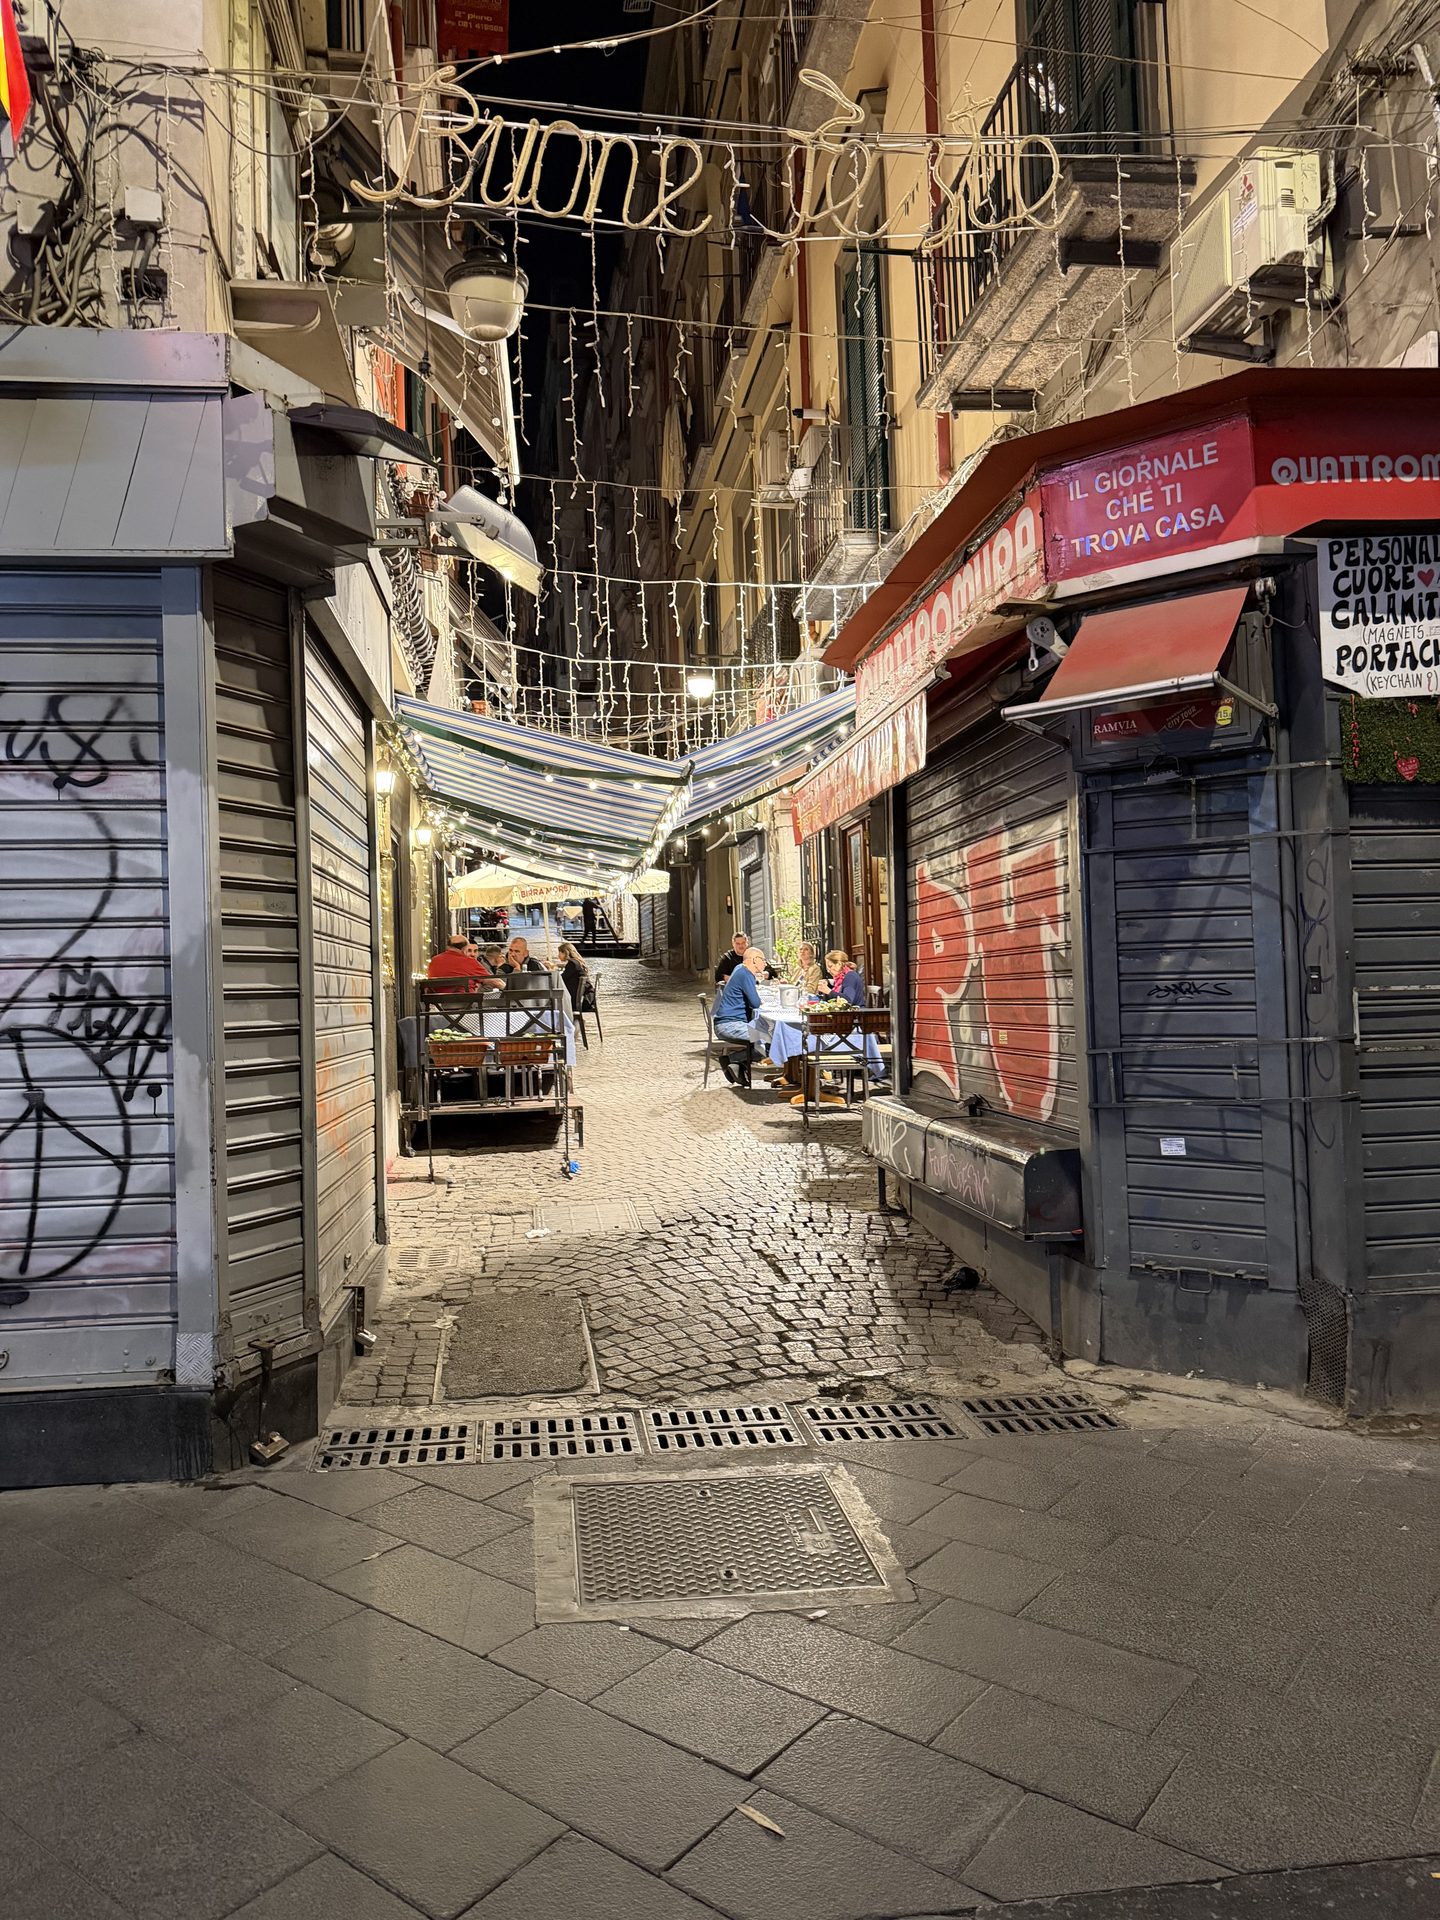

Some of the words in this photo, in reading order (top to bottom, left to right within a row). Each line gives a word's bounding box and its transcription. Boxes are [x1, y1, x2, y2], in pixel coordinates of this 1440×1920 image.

[350, 65, 712, 237] Buone
[1068, 479, 1089, 501] IL
[1094, 441, 1219, 494] GIORNALE
[1106, 489, 1154, 520] CHE
[1161, 482, 1182, 506] TI
[1071, 522, 1151, 558] TROVA
[1155, 503, 1225, 538] CASA
[1332, 565, 1416, 599] CUORE
[1093, 719, 1137, 735] RAMVIA
[1181, 705, 1197, 720] TOUR
[520, 887, 545, 898] BIRRA
